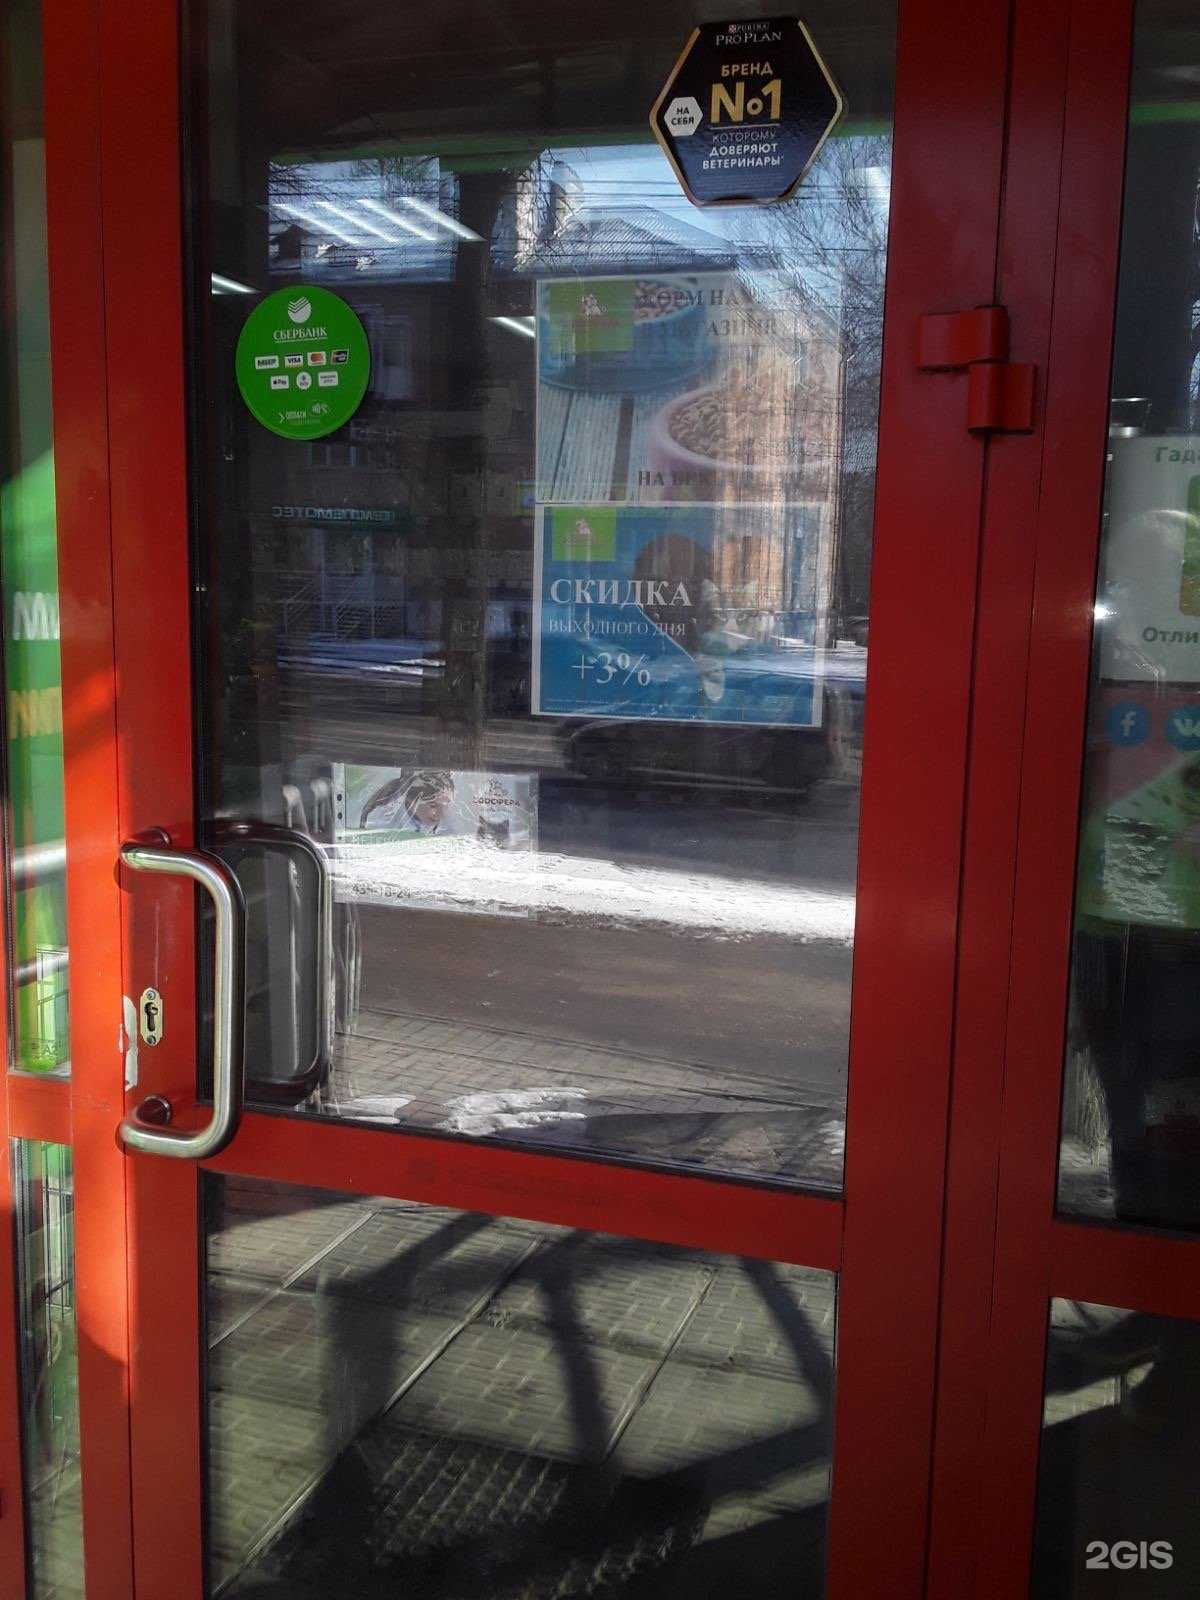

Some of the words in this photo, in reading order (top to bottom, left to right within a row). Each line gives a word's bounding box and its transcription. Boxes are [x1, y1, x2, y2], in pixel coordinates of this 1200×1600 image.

[721, 62, 773, 77] БРЕНД
[676, 107, 690, 115] НА
[671, 117, 695, 126] СЕБЯ
[712, 130, 776, 144] КОТОРОМУ
[709, 143, 778, 157] ДОВЕРЯЮТ
[273, 327, 328, 342] СБЕРБАНК
[549, 578, 693, 608] СКИДКА
[571, 652, 651, 687] +3%
